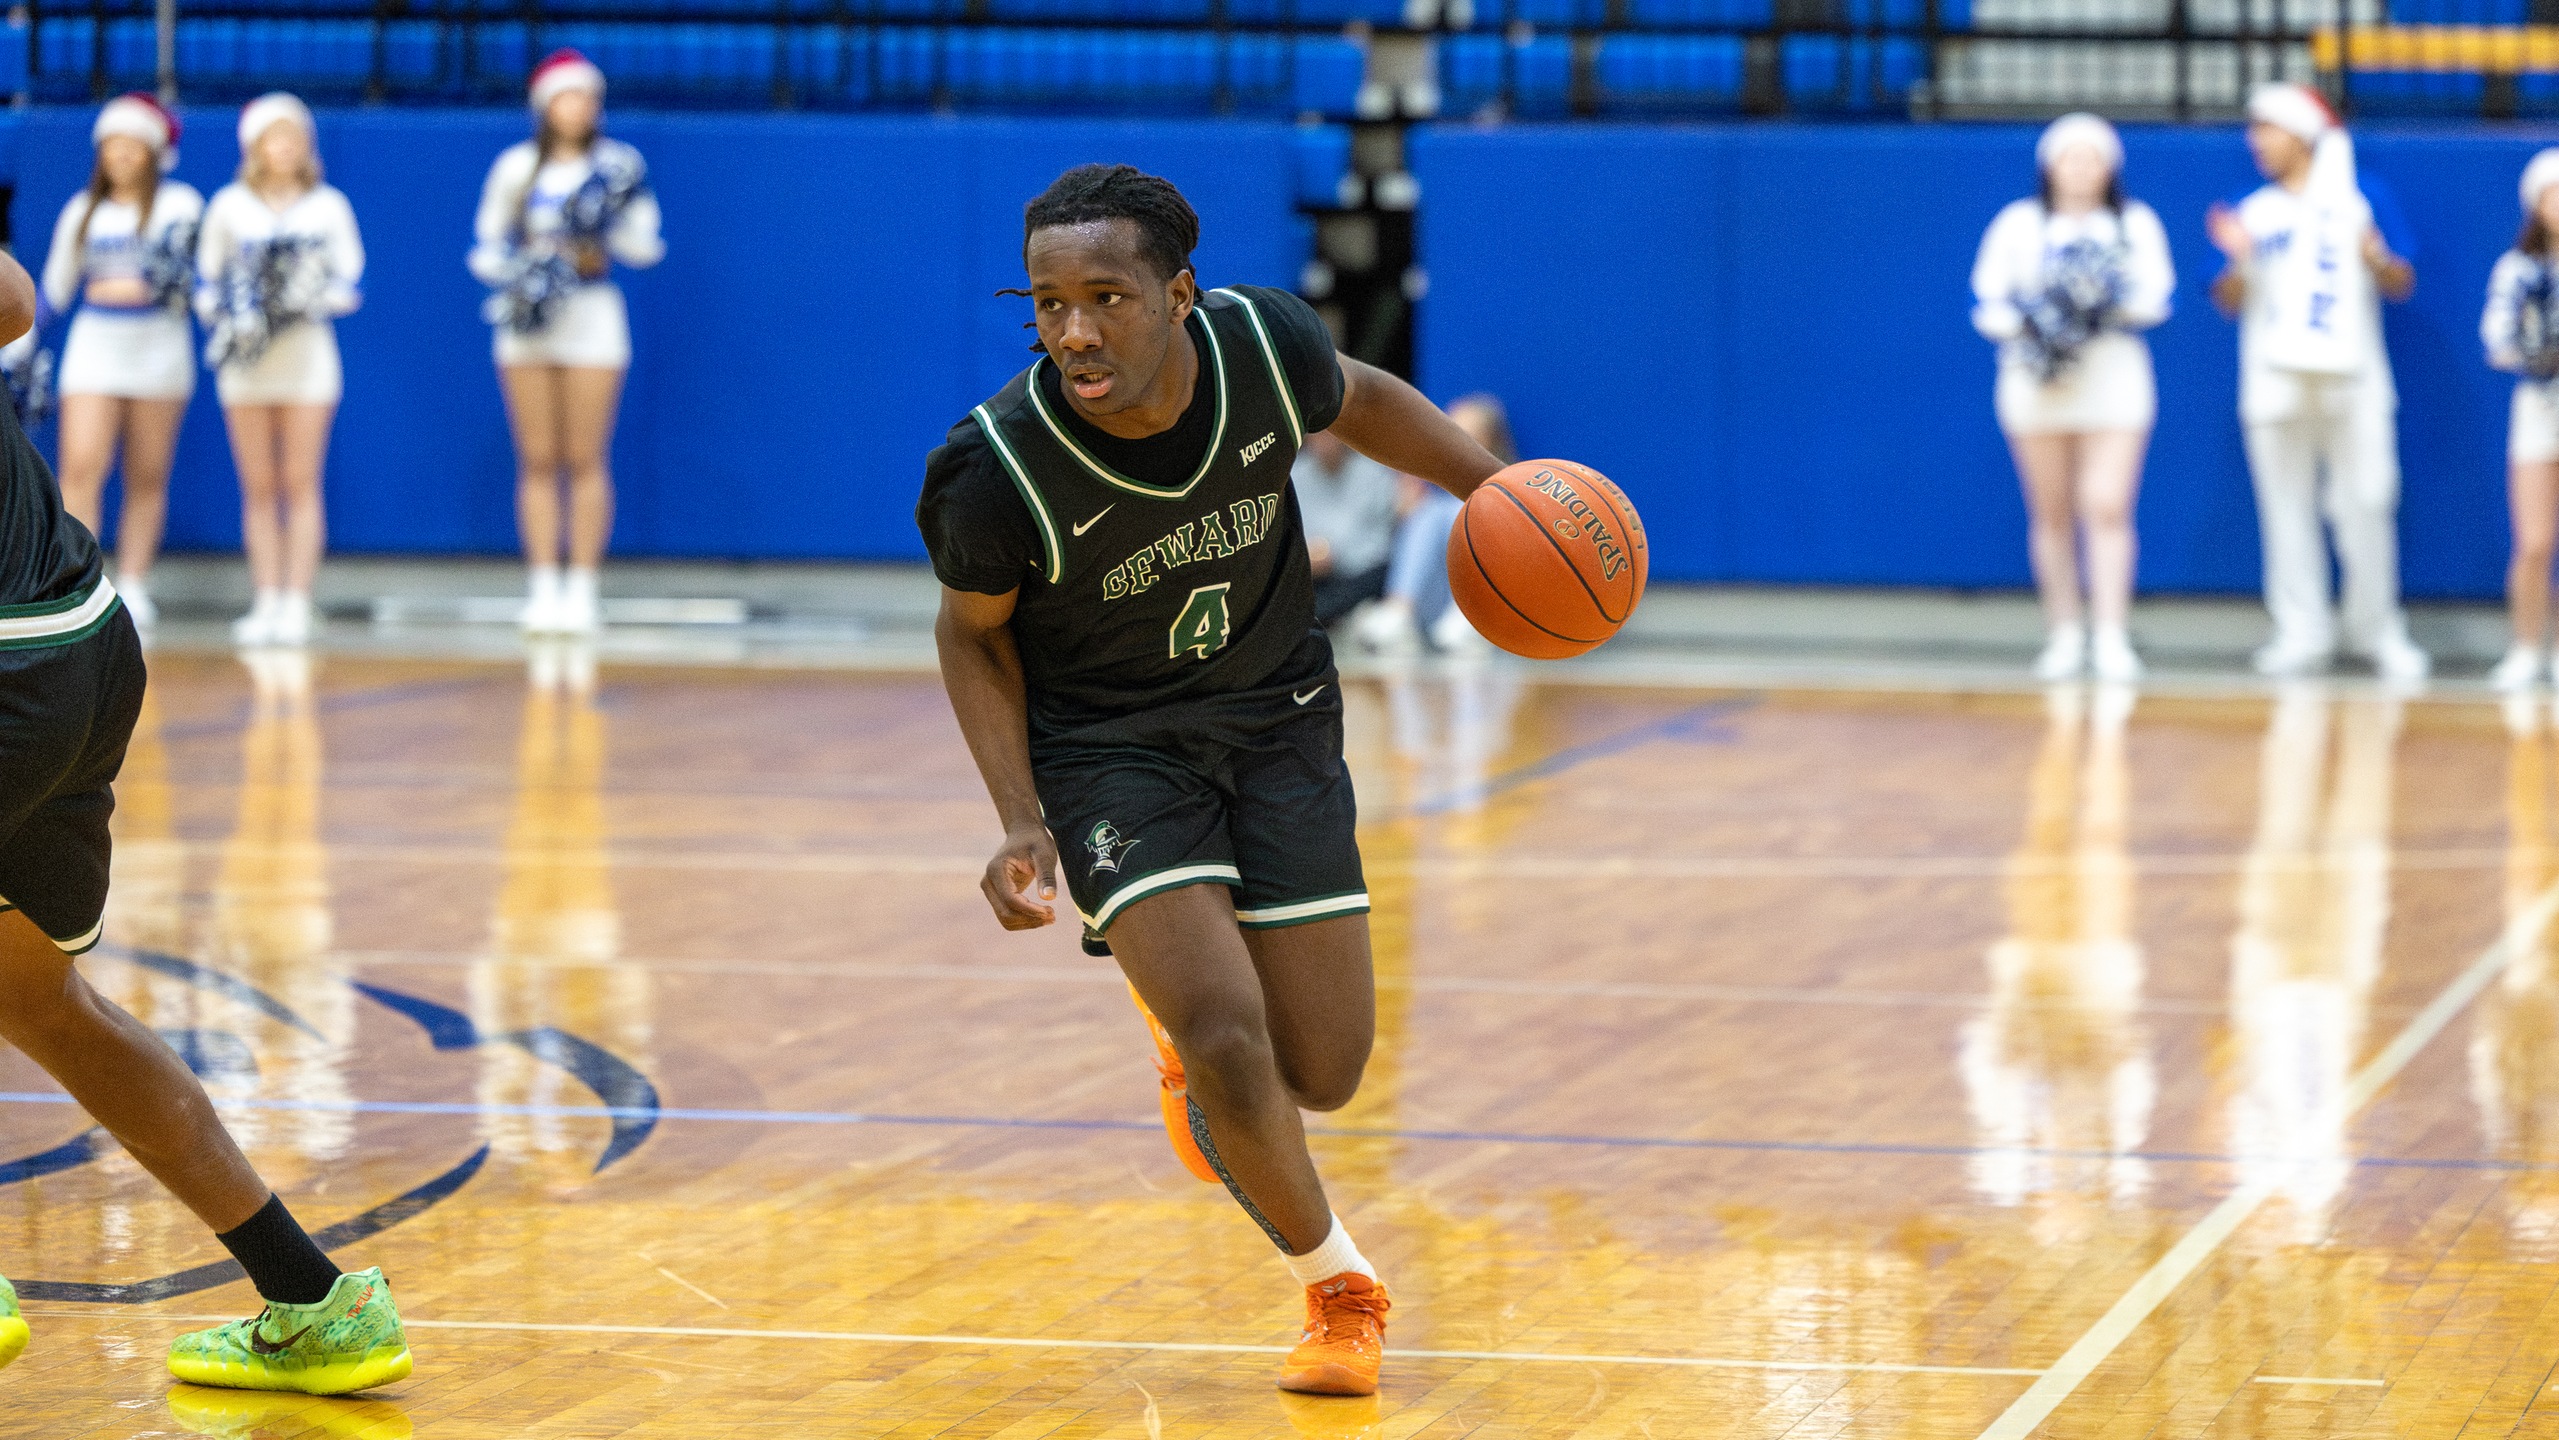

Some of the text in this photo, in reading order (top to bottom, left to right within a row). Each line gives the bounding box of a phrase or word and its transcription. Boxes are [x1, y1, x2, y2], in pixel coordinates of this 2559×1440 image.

[1239, 432, 1276, 467] KJCCC
[1526, 469, 1628, 581] SPALDING
[1169, 581, 1231, 660] 4
